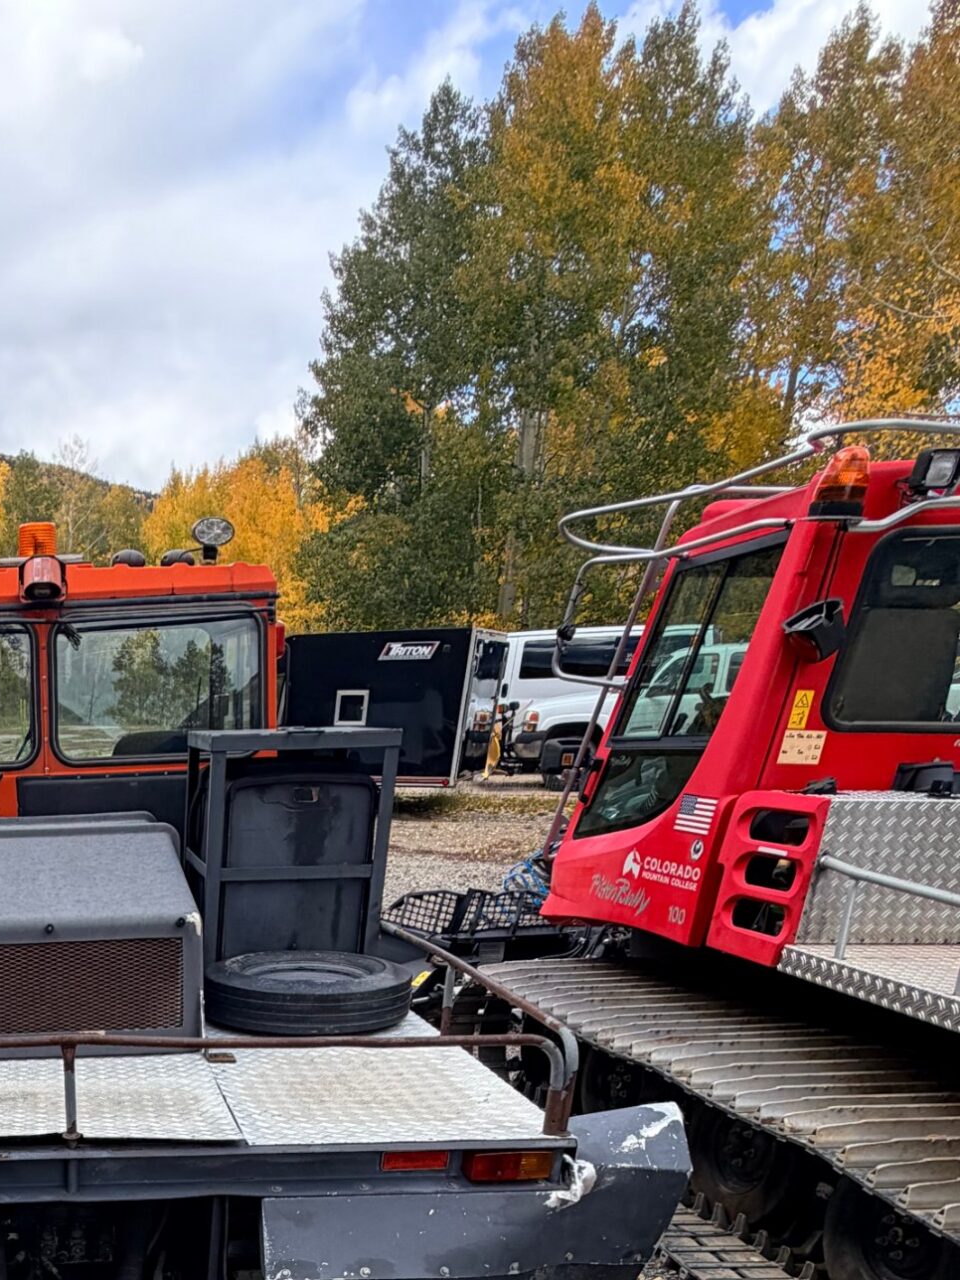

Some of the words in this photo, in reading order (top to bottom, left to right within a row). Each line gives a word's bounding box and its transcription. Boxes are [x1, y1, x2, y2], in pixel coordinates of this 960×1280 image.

[388, 643, 432, 656] TRITON
[643, 856, 701, 881] COLORADO
[641, 870, 670, 885] MOUNTAIN
[670, 877, 698, 892] COLLEGE
[667, 905, 686, 925] 100
